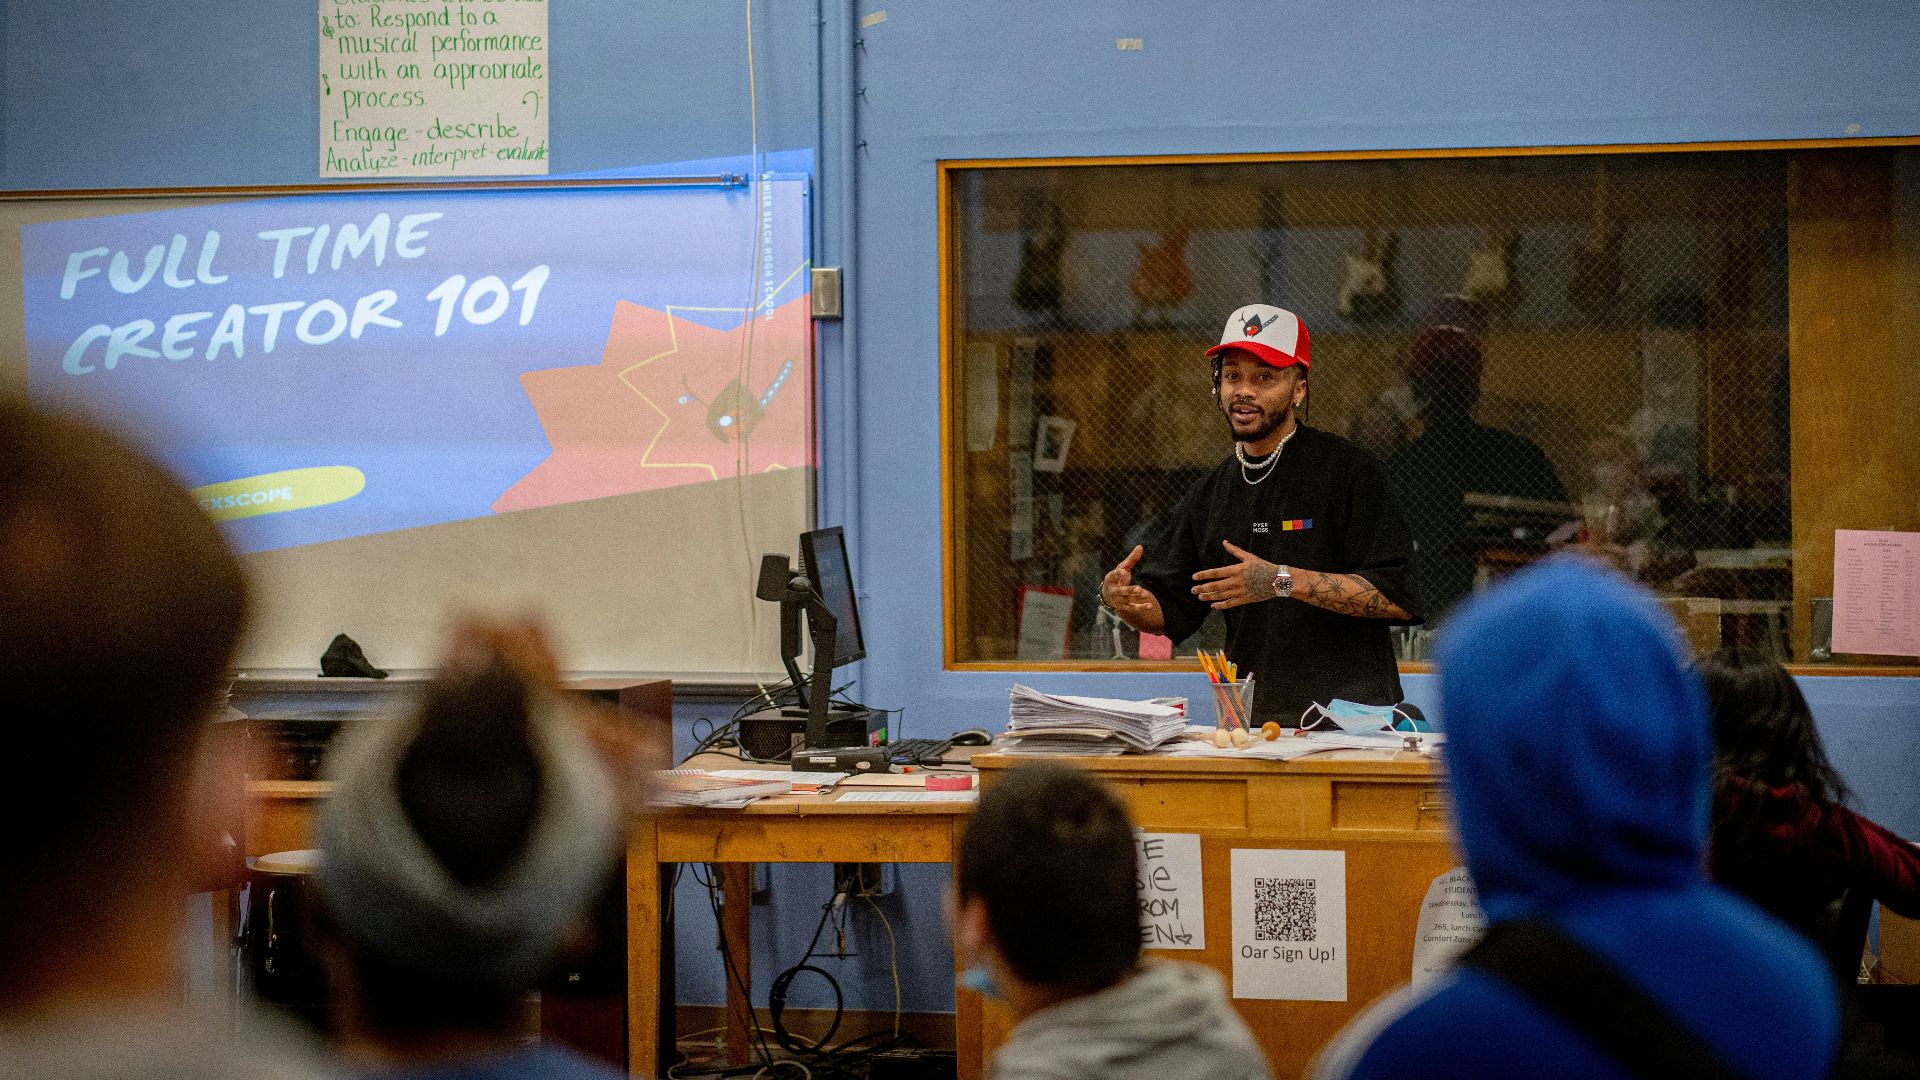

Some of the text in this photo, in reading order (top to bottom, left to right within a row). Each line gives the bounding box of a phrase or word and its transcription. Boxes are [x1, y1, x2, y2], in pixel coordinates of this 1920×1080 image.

[370, 4, 451, 35] Respond
[457, 5, 478, 26] to
[483, 10, 499, 26] a
[338, 28, 544, 62] musical performance
[340, 56, 544, 90] with an appropriate
[333, 120, 409, 151] Engage
[60, 211, 443, 300] FULL TIME
[61, 264, 550, 376] CREATOR 101
[1241, 945, 1335, 964] Oar Sign Up!
